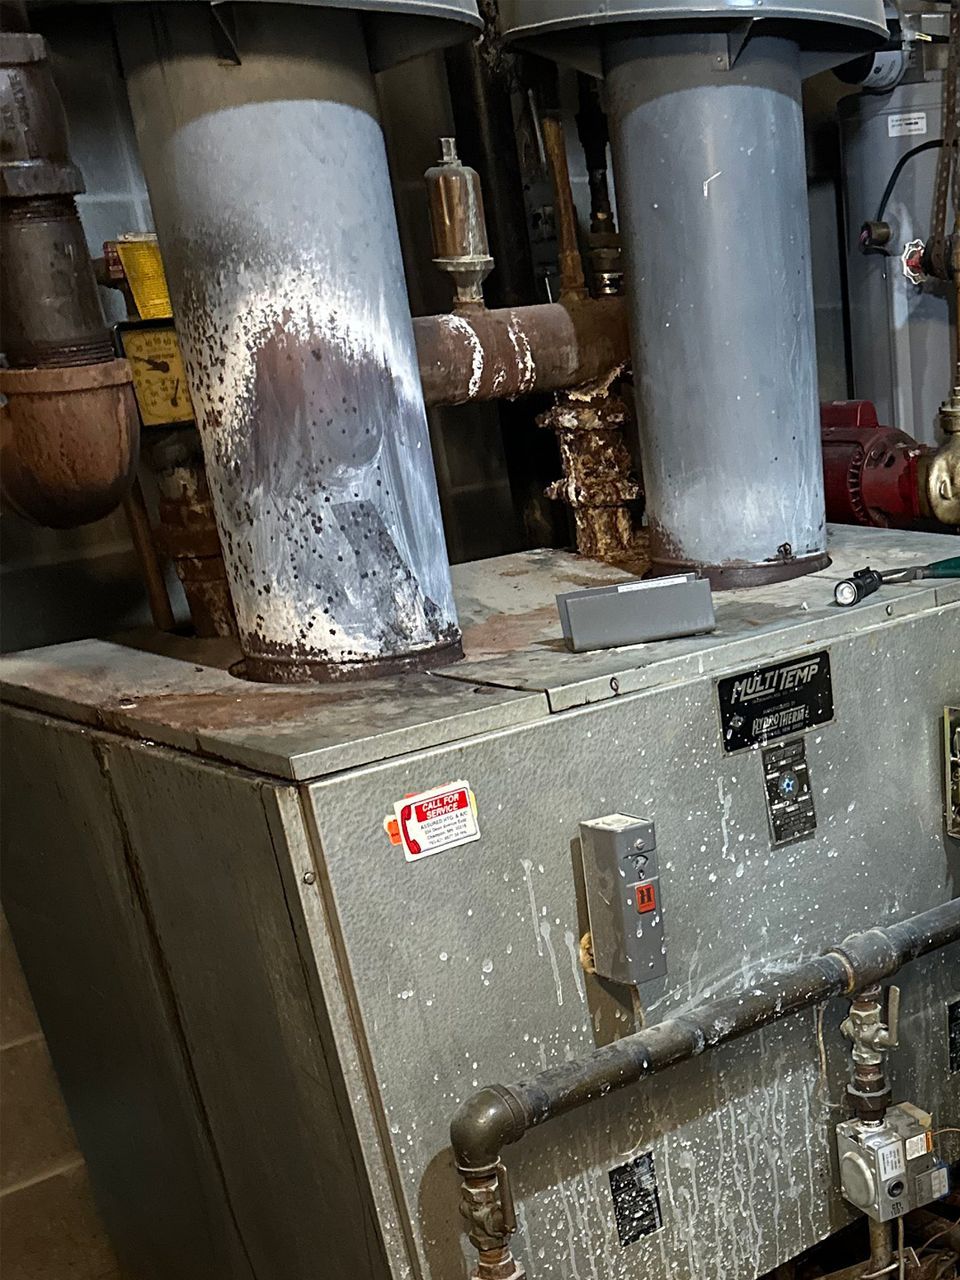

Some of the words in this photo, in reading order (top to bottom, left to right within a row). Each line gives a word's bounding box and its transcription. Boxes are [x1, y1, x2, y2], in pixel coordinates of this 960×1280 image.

[731, 659, 820, 705] MULTITEMP
[422, 798, 443, 812] CALL
[443, 793, 460, 805] FOR
[426, 802, 459, 819] SERVICE
